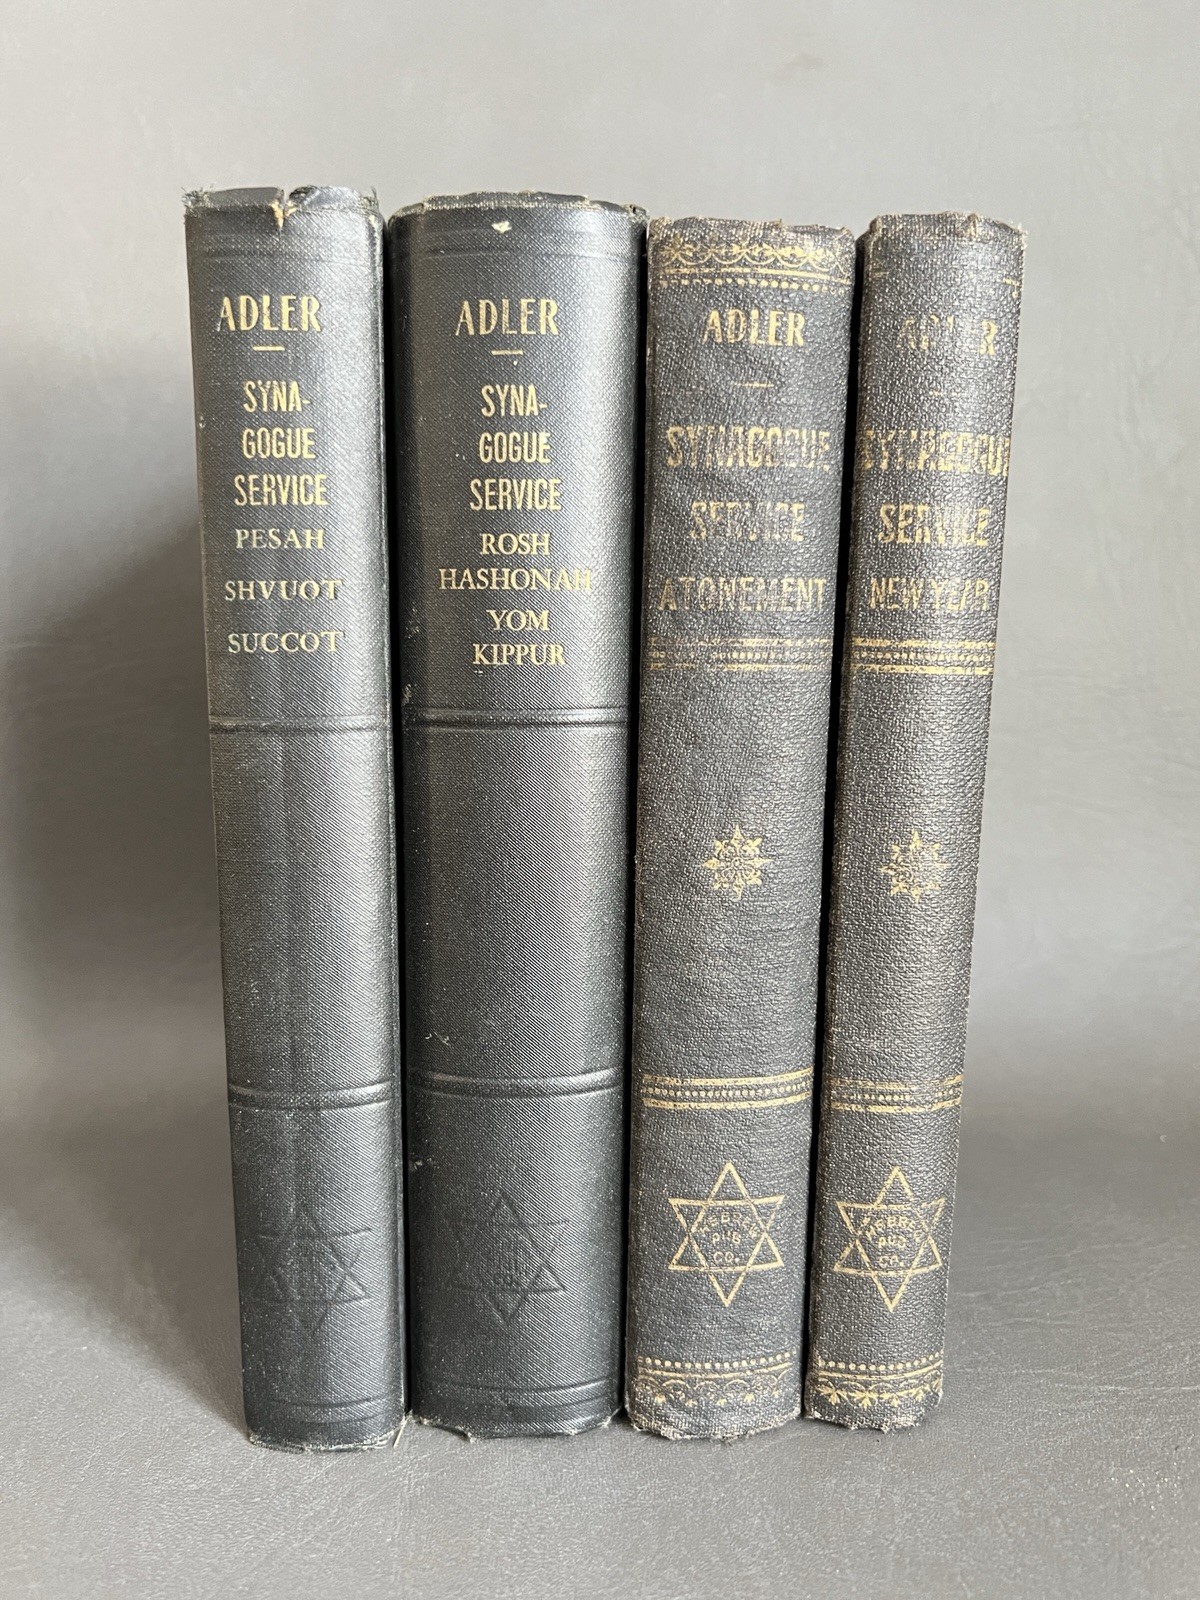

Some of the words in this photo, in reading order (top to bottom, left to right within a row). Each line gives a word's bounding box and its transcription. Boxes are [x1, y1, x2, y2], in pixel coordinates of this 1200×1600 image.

[217, 295, 322, 332] ADLER
[455, 298, 560, 336] ADLER
[703, 309, 806, 347] ADLER
[243, 380, 311, 413] SYNA-
[481, 384, 548, 417] SYNA-
[242, 427, 316, 460] GOGUE
[479, 432, 552, 464] GOGUE
[234, 473, 328, 507] SERVICE
[470, 478, 562, 512] SERVICE
[235, 528, 325, 550] PESAH
[480, 532, 551, 556] ROSH
[225, 578, 344, 601] SHVUOT
[439, 567, 592, 591] HASHONAH
[658, 575, 828, 612] ATONEMENT
[487, 608, 550, 632] YOM
[228, 630, 344, 654] SUCCOT
[472, 642, 567, 666] KIPPUR
